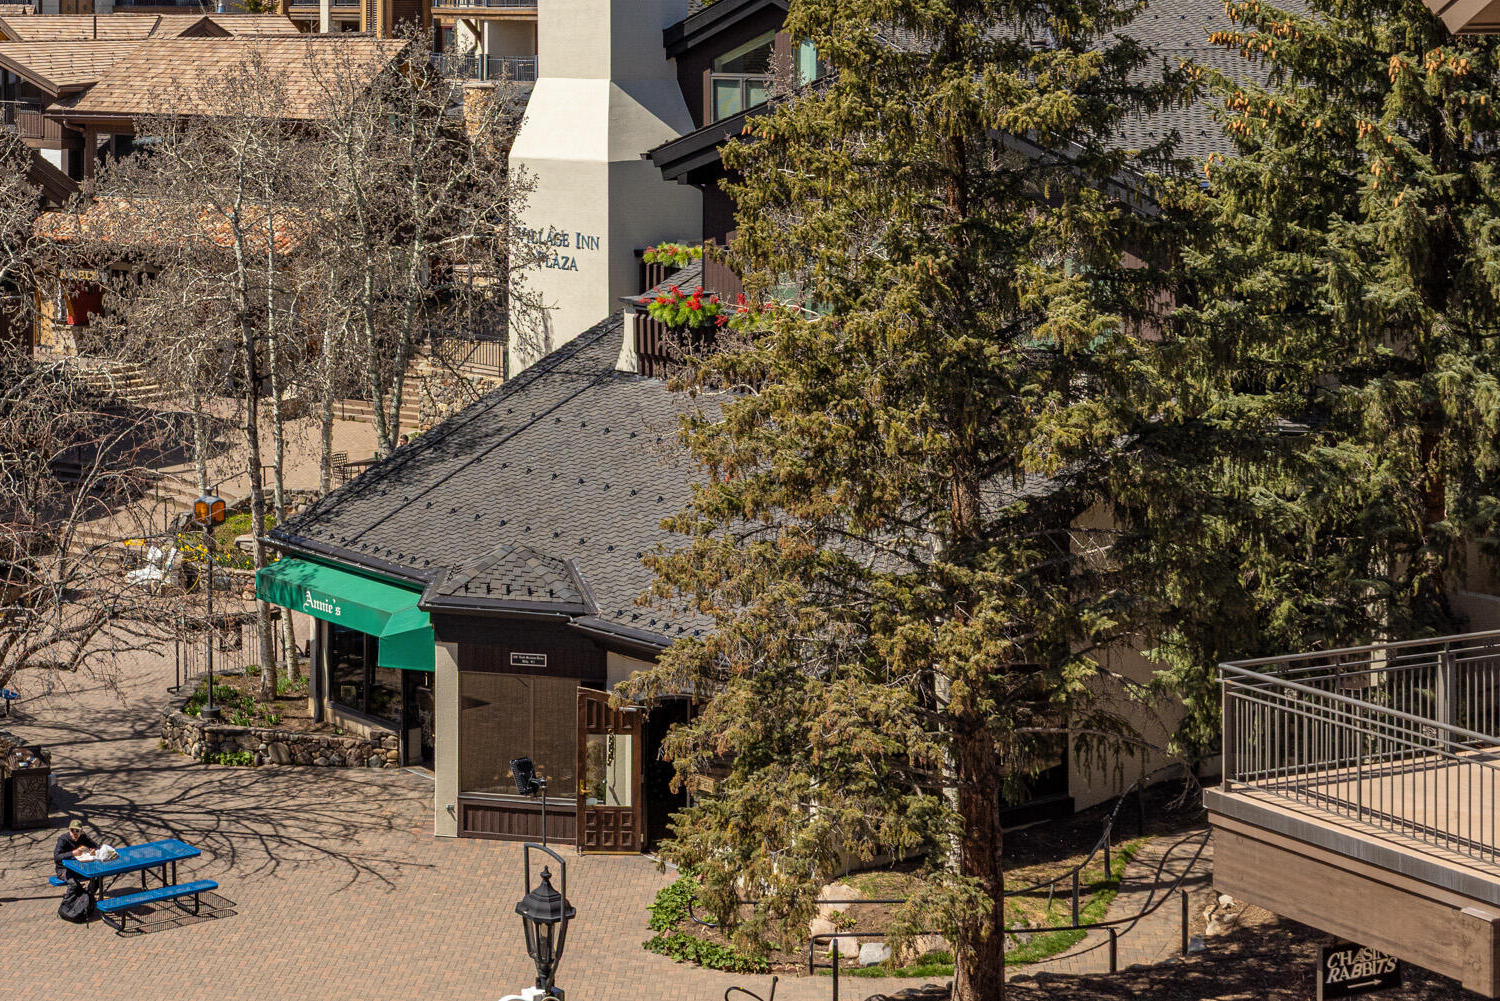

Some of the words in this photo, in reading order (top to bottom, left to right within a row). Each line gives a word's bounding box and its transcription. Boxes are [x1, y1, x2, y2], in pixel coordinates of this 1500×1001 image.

[575, 231, 600, 250] INN
[302, 590, 341, 616] Annie's
[1325, 956, 1398, 984] RABBITS
